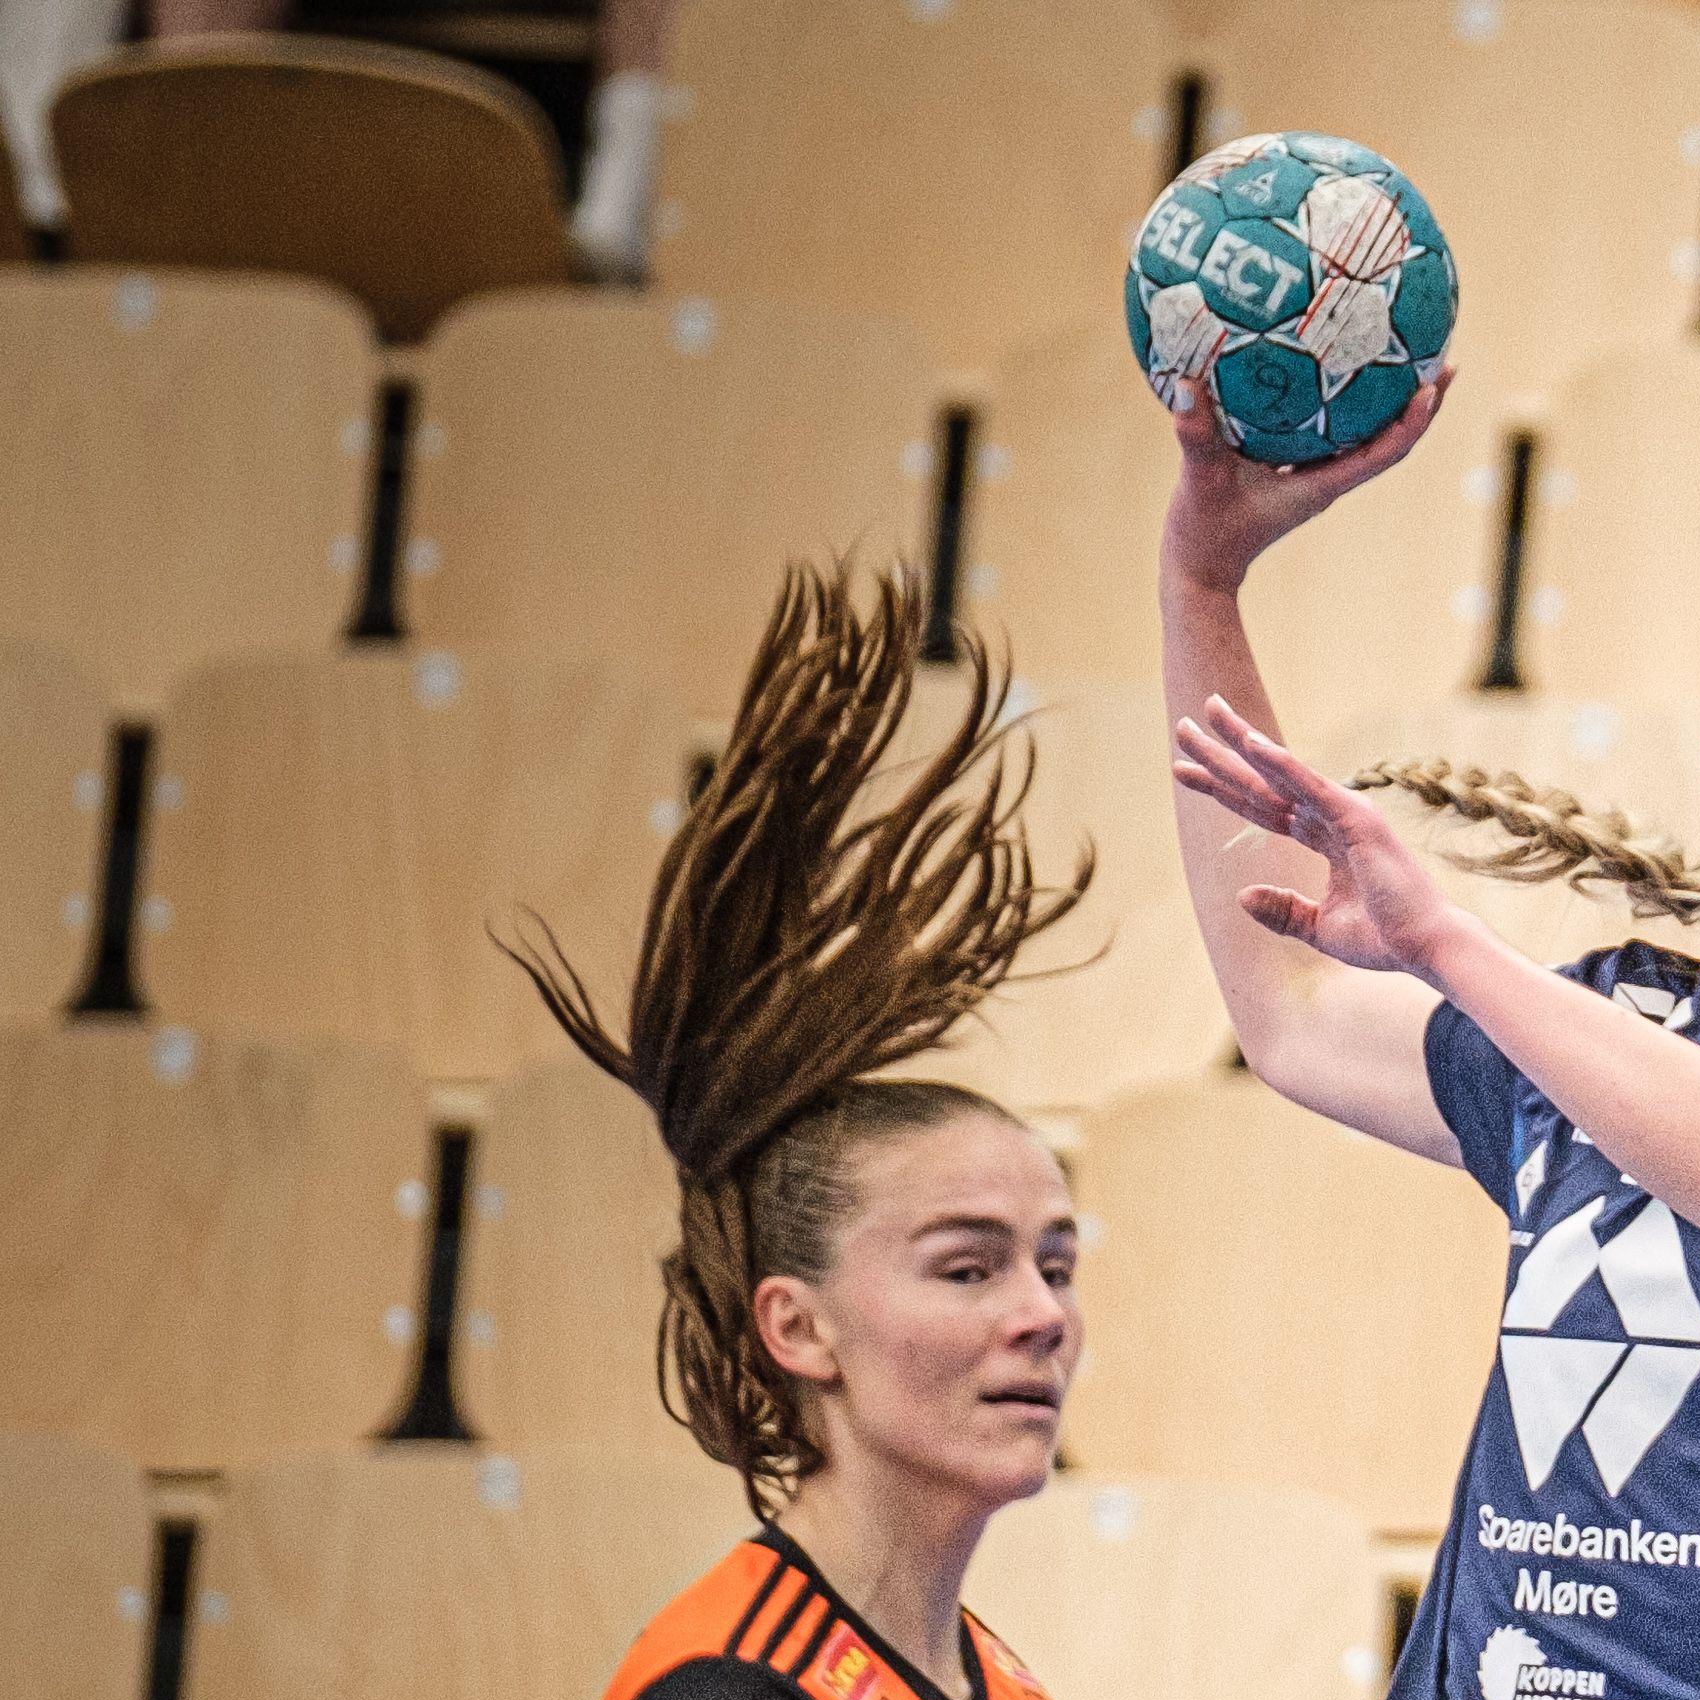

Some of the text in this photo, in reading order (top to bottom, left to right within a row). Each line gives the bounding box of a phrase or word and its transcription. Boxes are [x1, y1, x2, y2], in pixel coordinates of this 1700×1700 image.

[1141, 200, 1306, 314] SELECT
[1513, 1568, 1619, 1619] Møre
[1516, 1665, 1607, 1697] KOPPEN
